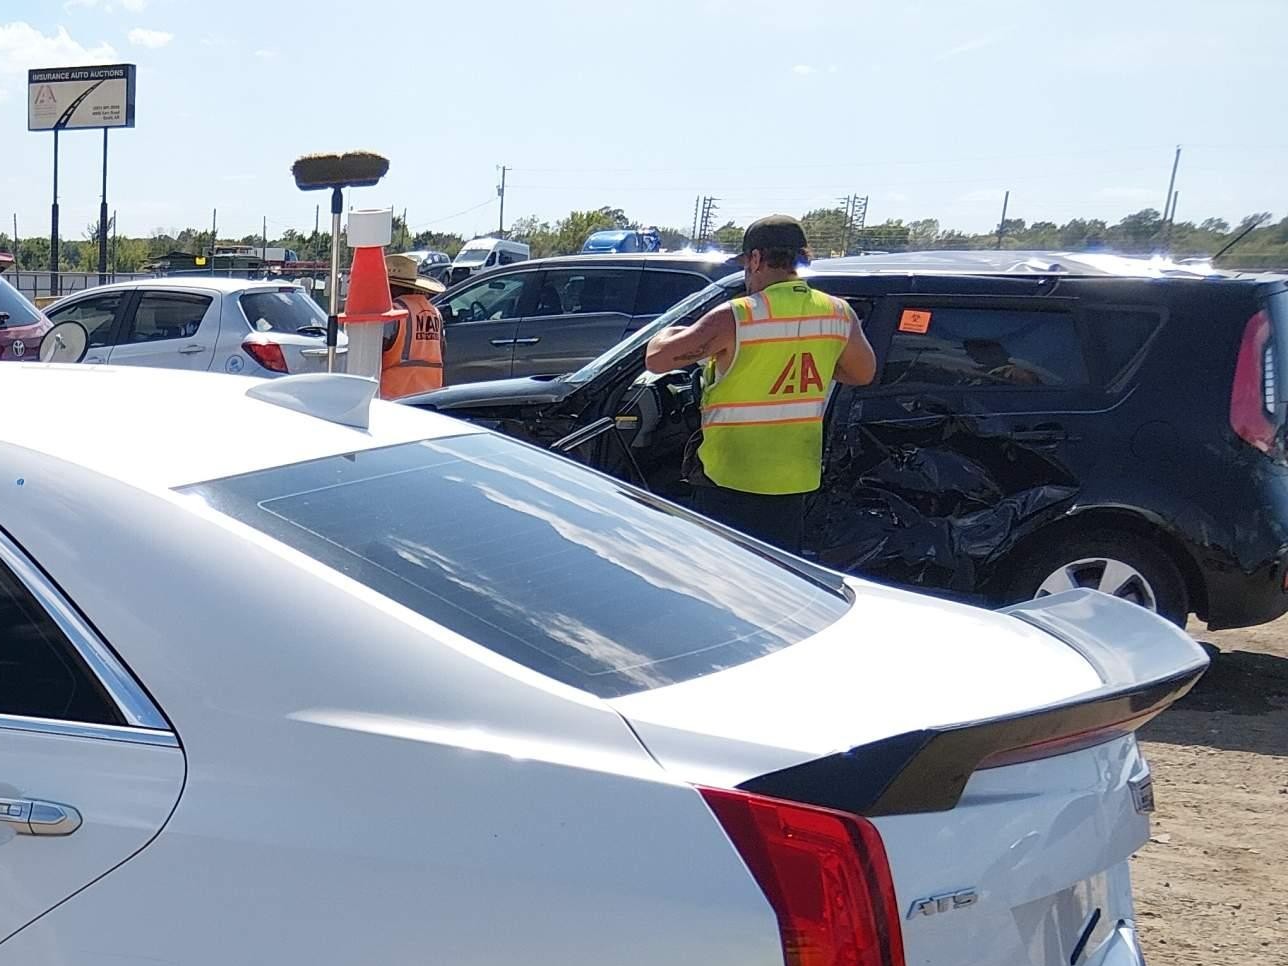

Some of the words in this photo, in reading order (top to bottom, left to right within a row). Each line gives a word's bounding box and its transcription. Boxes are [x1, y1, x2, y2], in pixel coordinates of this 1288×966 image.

[33, 72, 70, 81] INSURANCE
[71, 71, 89, 79] AUTO
[90, 69, 124, 78] AUCTIONS
[905, 886, 977, 921] ATS
